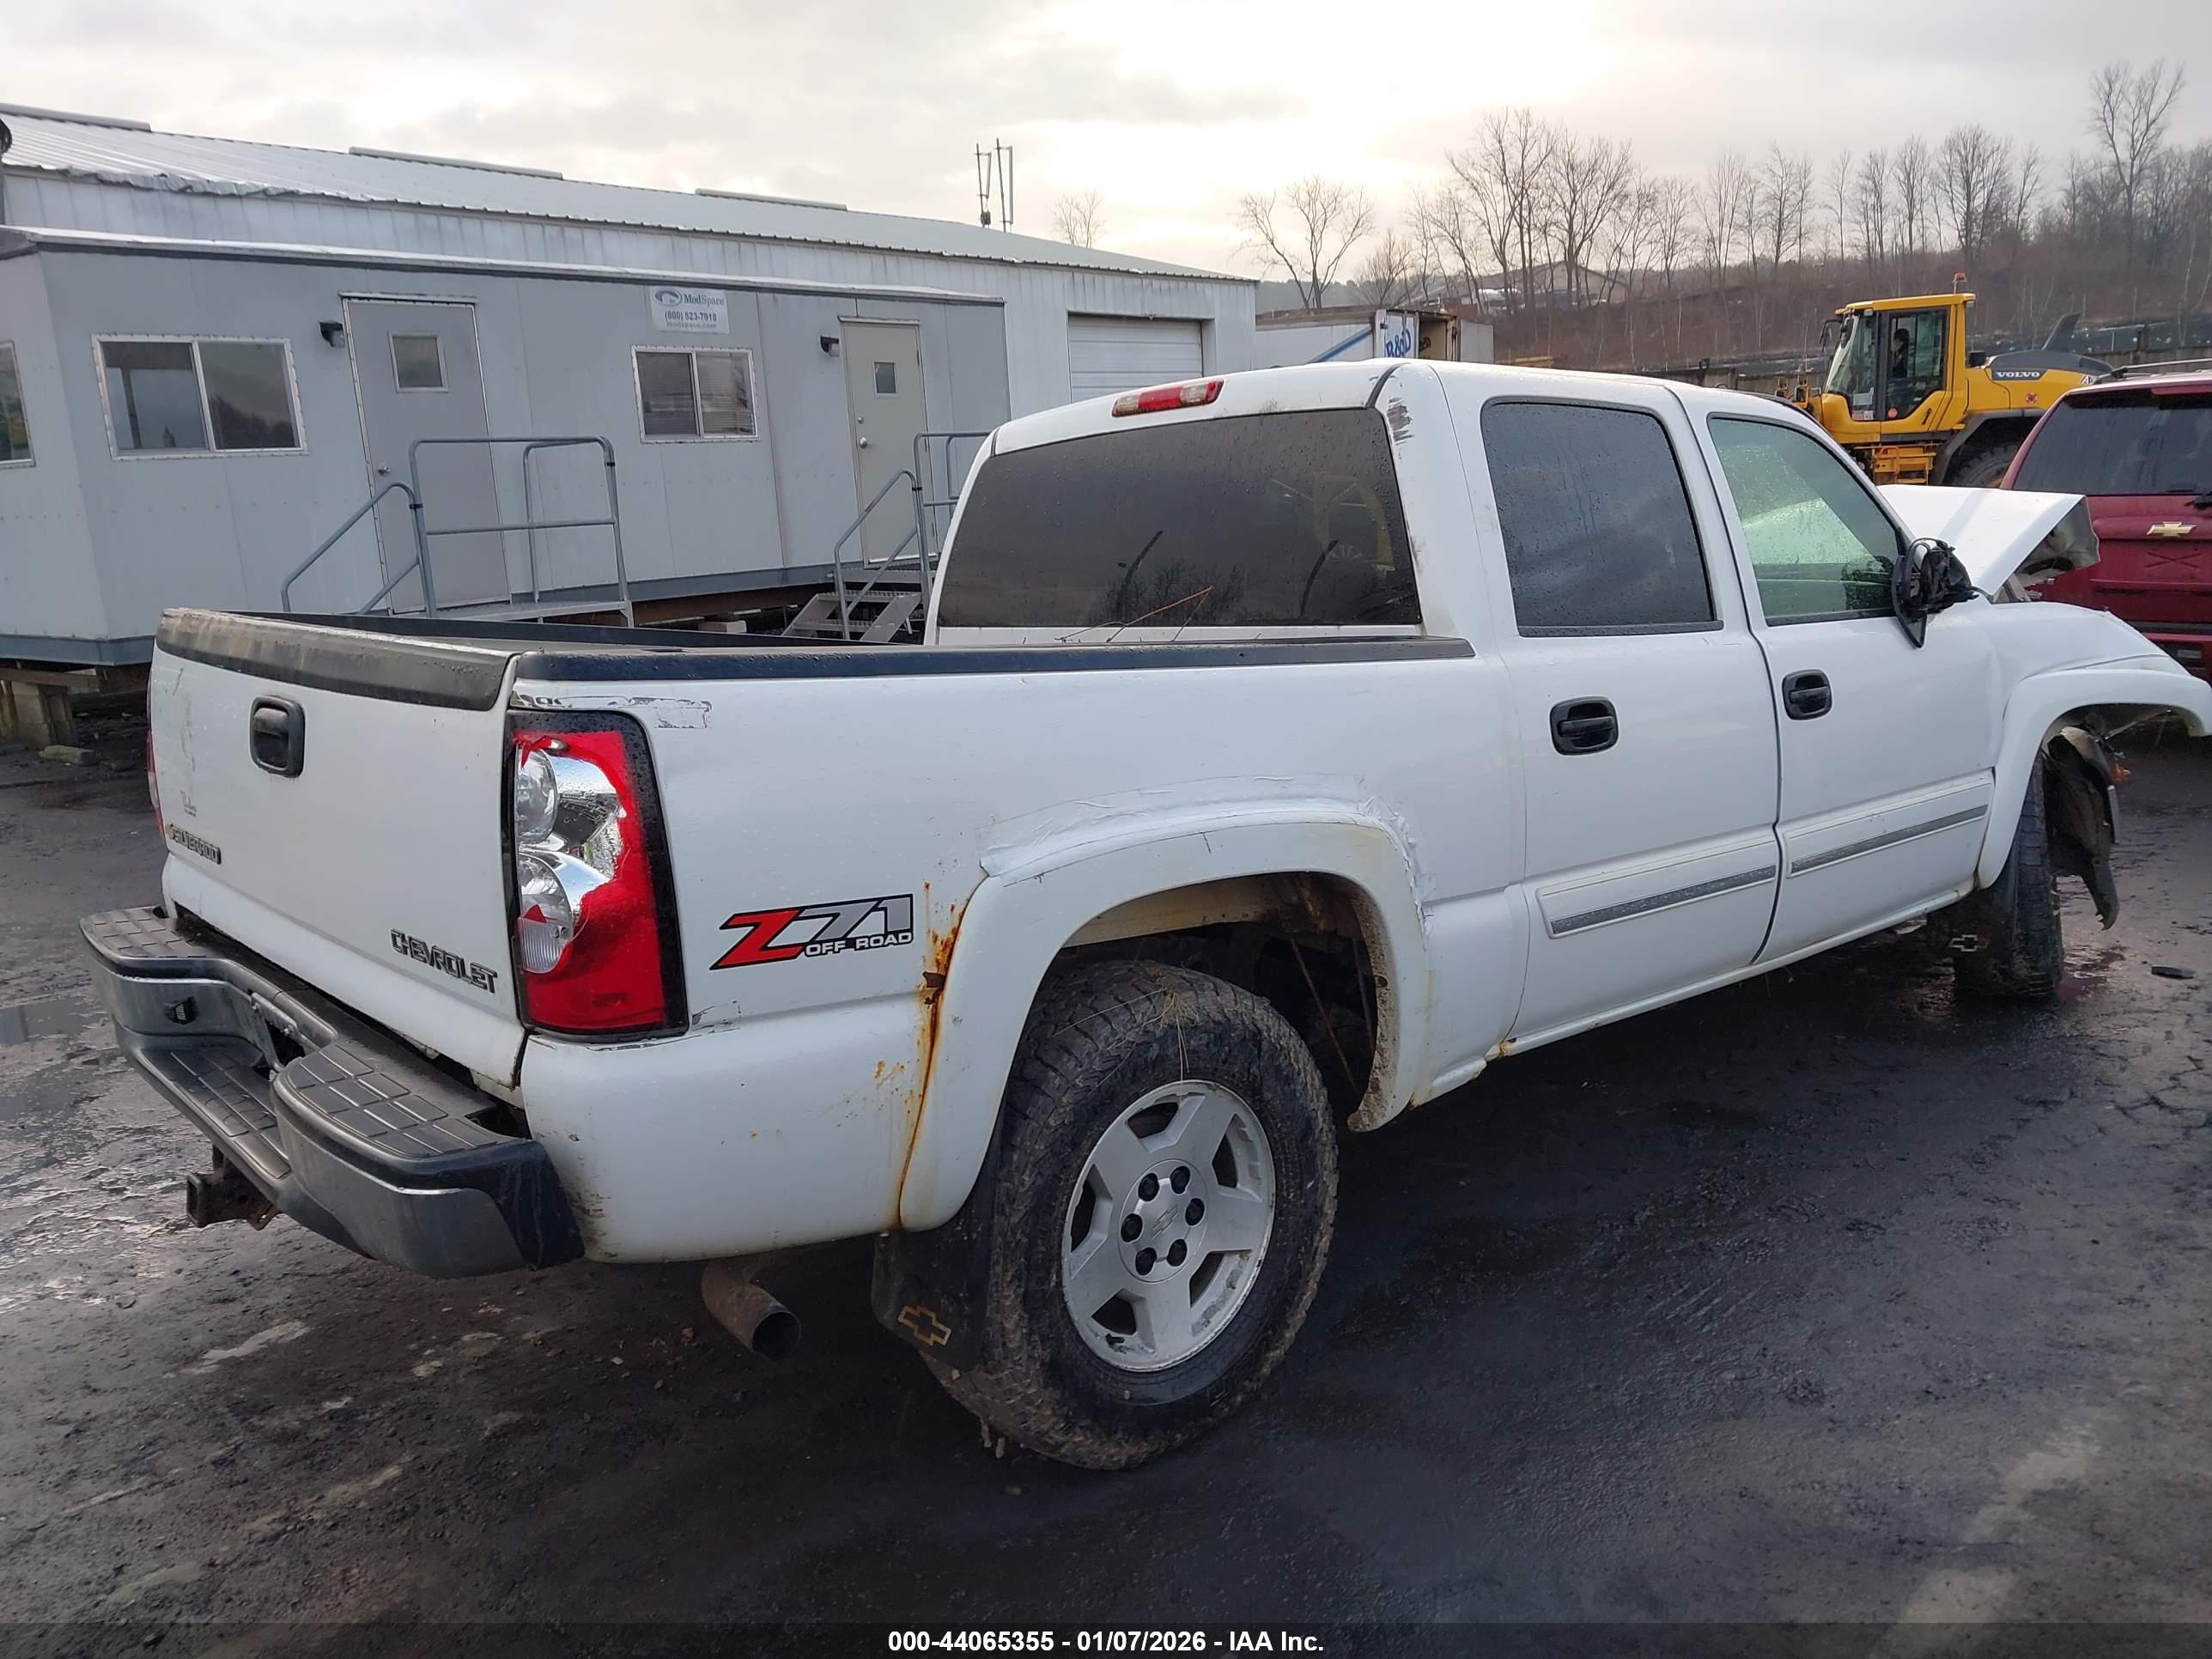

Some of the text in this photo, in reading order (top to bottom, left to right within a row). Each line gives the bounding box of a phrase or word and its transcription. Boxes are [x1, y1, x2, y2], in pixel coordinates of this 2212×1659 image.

[684, 294, 724, 307] ModSpace
[665, 310, 684, 322] (800)
[709, 894, 913, 970] Z71
[805, 932, 913, 957] OFF ROAD
[390, 928, 498, 994] CHEVROLET
